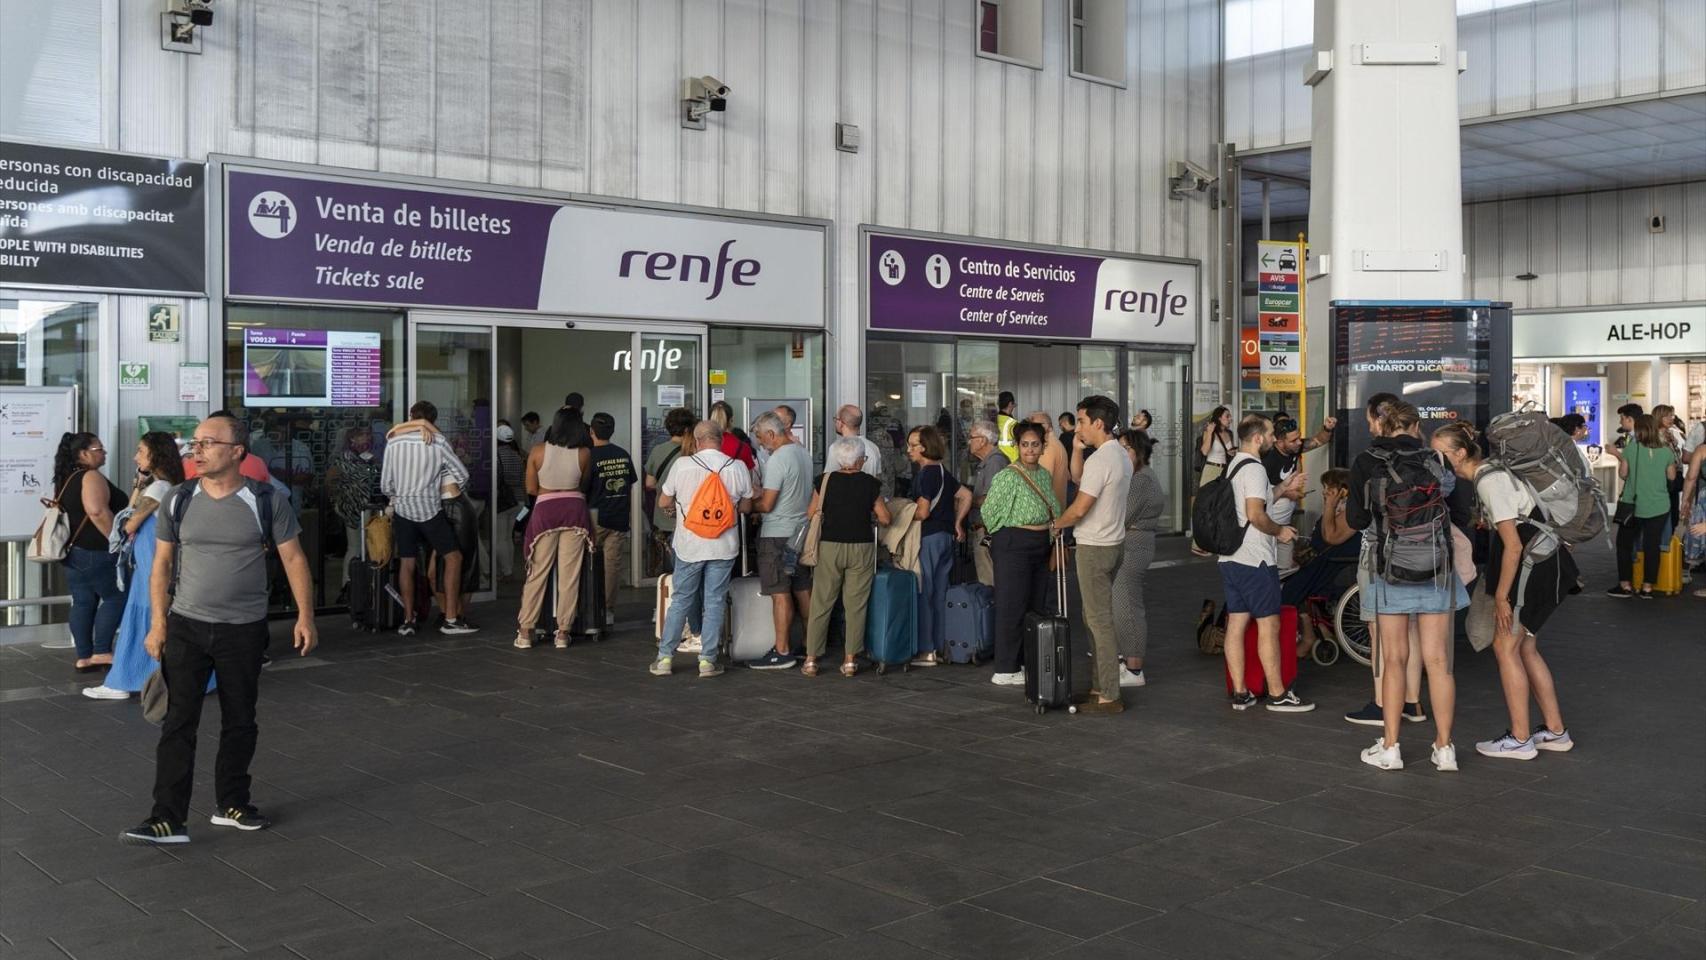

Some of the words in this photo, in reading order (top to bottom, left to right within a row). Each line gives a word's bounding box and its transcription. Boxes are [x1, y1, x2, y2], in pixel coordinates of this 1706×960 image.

[64, 164, 92, 178] con
[97, 167, 193, 188] discapacidad
[57, 203, 88, 216] amb
[93, 204, 174, 223] discapacitat
[315, 196, 385, 224] Venta
[393, 203, 421, 227] de
[430, 205, 511, 235] billetes
[34, 240, 66, 254] WITH
[70, 243, 144, 259] DISABILITIES
[315, 233, 375, 255] Venda
[381, 238, 403, 257] de
[409, 240, 472, 262] bitllets
[0, 254, 39, 268] BILITY
[619, 239, 761, 300] renfe
[959, 256, 1001, 277] Centro
[1005, 259, 1019, 278] de
[1023, 261, 1076, 283] Servicios
[315, 266, 380, 288] Tickets
[386, 271, 424, 290] sale
[1270, 274, 1286, 282] AVIS
[959, 283, 993, 301] Centre
[995, 285, 1008, 301] de
[1010, 287, 1045, 303] Serveis
[1104, 279, 1187, 327] renfe
[1264, 298, 1292, 307] Europcar
[960, 307, 994, 323] Center
[996, 308, 1008, 327] of
[1009, 310, 1048, 326] Services
[1607, 322, 1691, 341] ALE-HOP
[612, 339, 682, 382] renfe
[1269, 355, 1287, 366] OK
[1355, 364, 1414, 372] LEONARDO
[1430, 411, 1457, 419] NIRO
